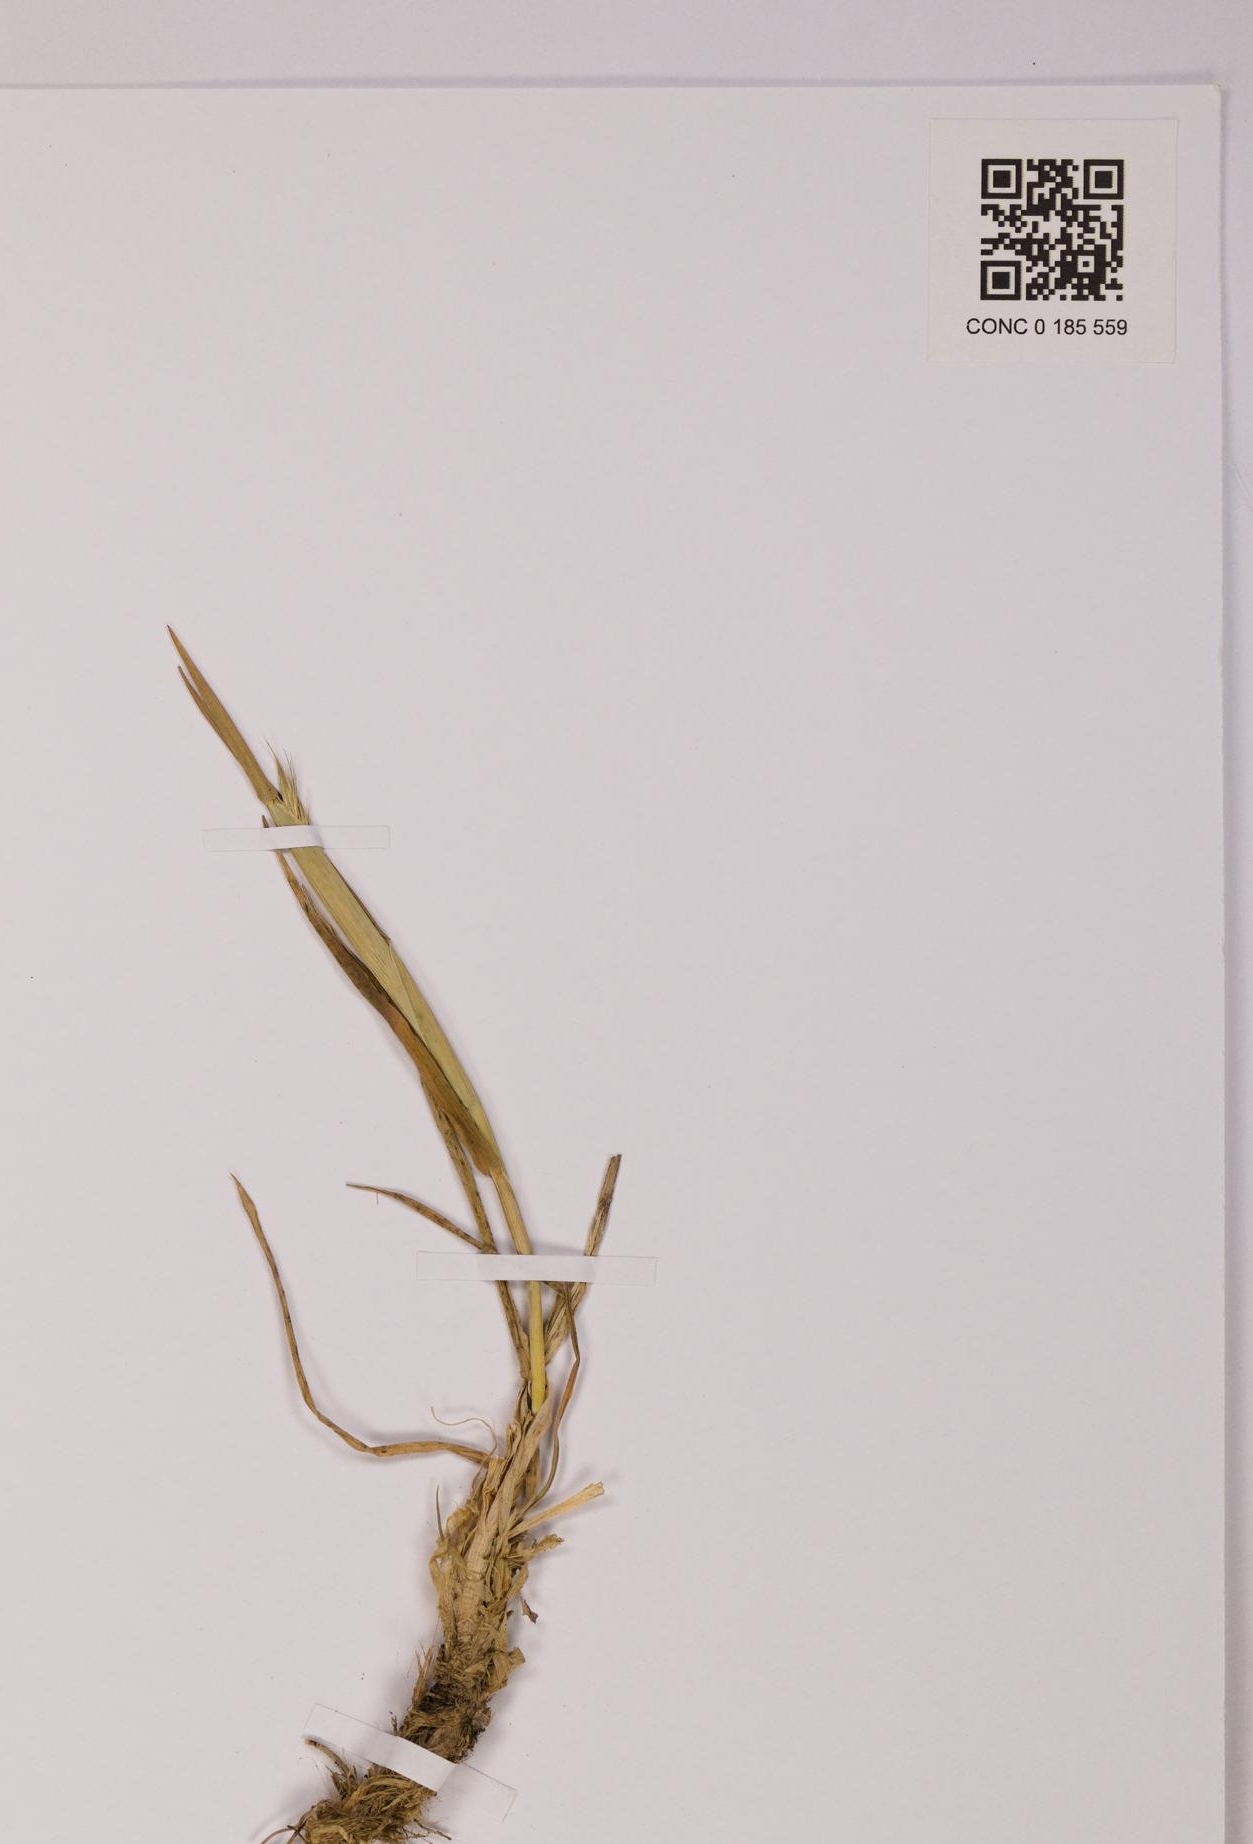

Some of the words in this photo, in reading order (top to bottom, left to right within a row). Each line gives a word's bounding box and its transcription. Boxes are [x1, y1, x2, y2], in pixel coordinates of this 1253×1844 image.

[966, 317, 1028, 335] CONC
[1034, 318, 1046, 335] 0
[1053, 318, 1087, 336] 185
[1093, 318, 1128, 336] 559
